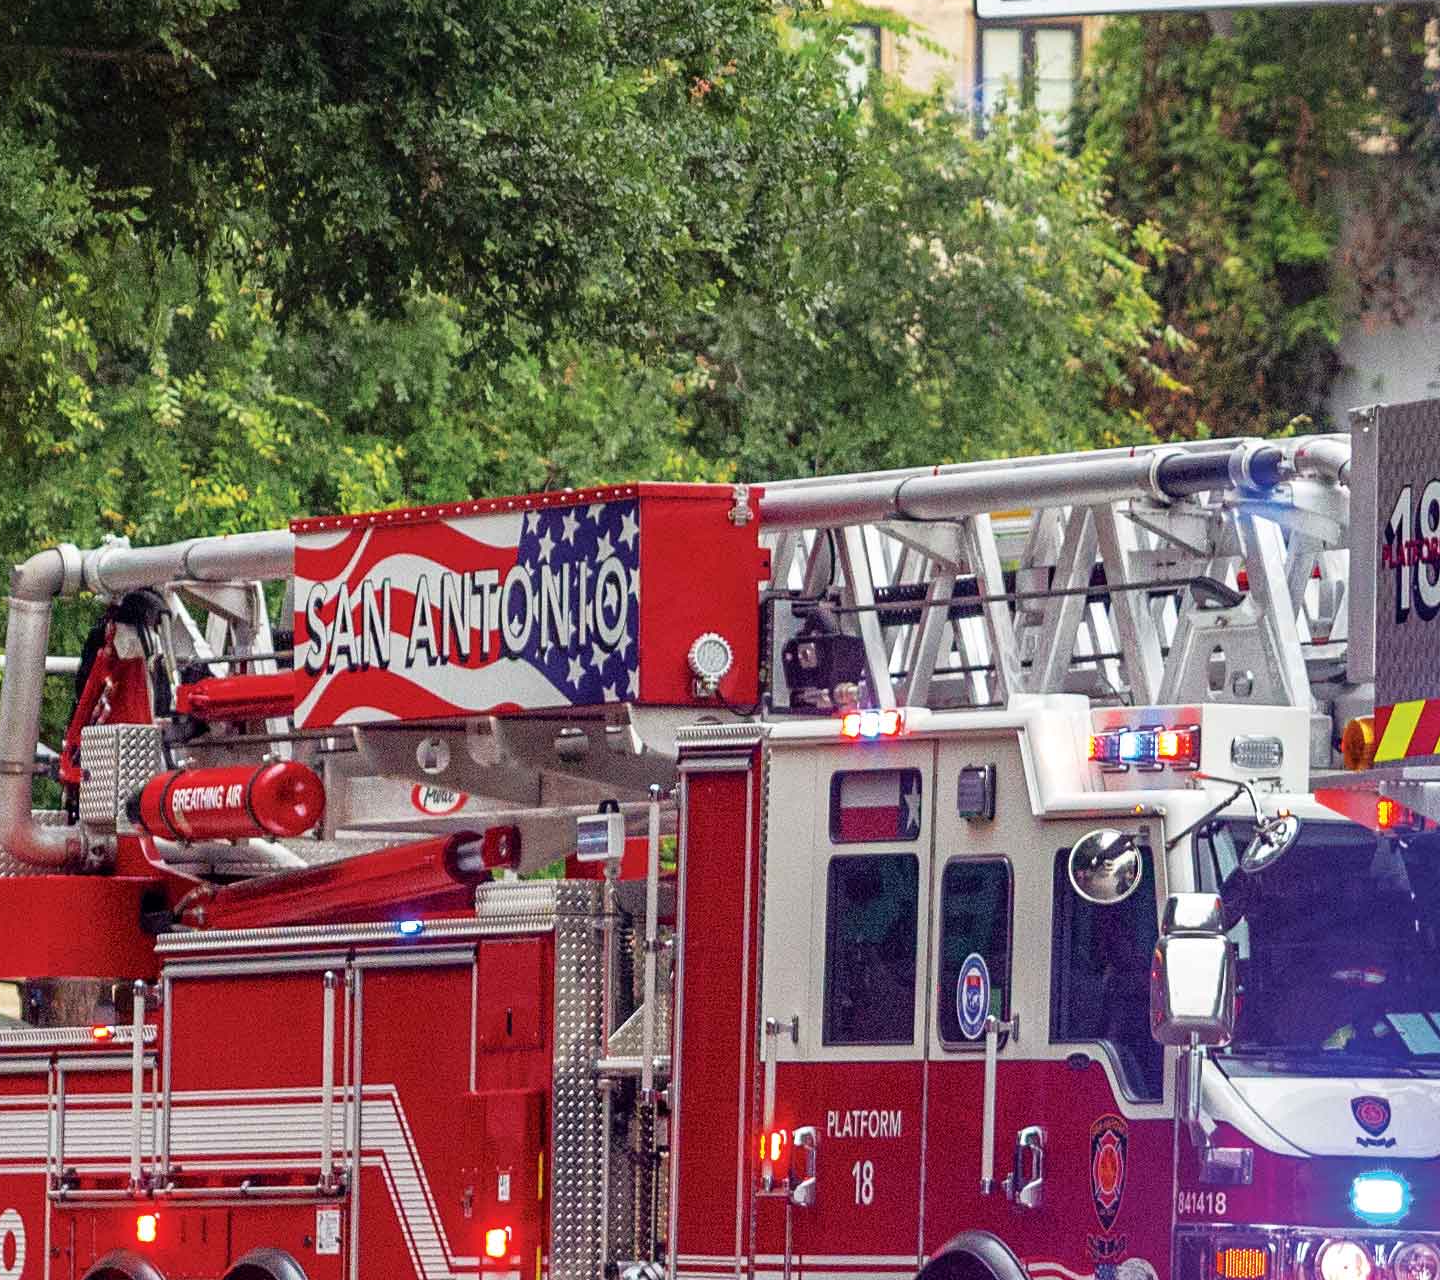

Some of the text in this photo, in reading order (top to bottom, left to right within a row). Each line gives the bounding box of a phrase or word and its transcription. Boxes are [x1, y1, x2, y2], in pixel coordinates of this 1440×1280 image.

[305, 556, 629, 675] SAN ANTONIO
[172, 784, 242, 812] BREATHING AIR
[827, 1109, 902, 1138] PLATFORM
[852, 1160, 874, 1206] 18
[1178, 1192, 1227, 1216] 841418
